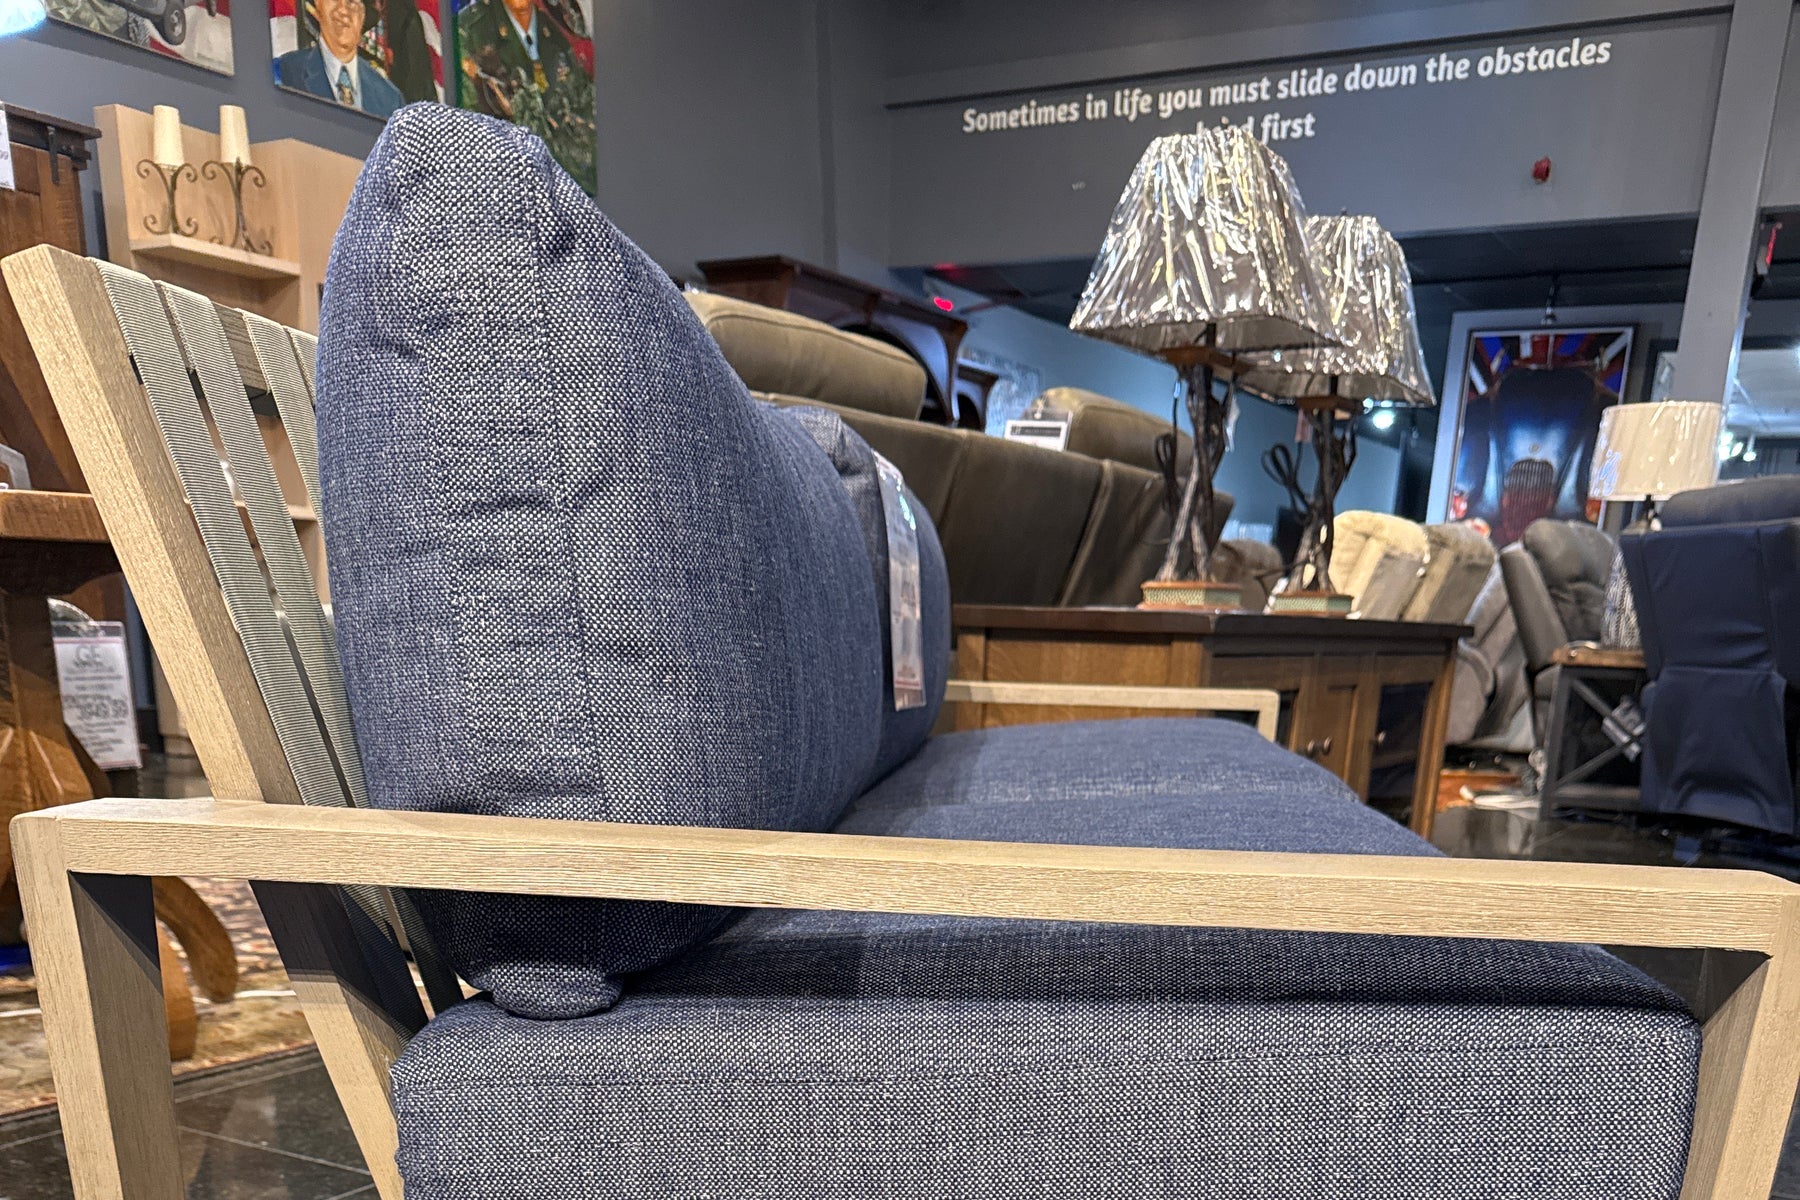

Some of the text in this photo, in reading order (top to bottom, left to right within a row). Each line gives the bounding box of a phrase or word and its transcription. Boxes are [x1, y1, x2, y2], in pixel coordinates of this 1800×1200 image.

[963, 37, 1612, 133] Sometimes in life you must slide down the obstacles
[1261, 112, 1317, 146] first
